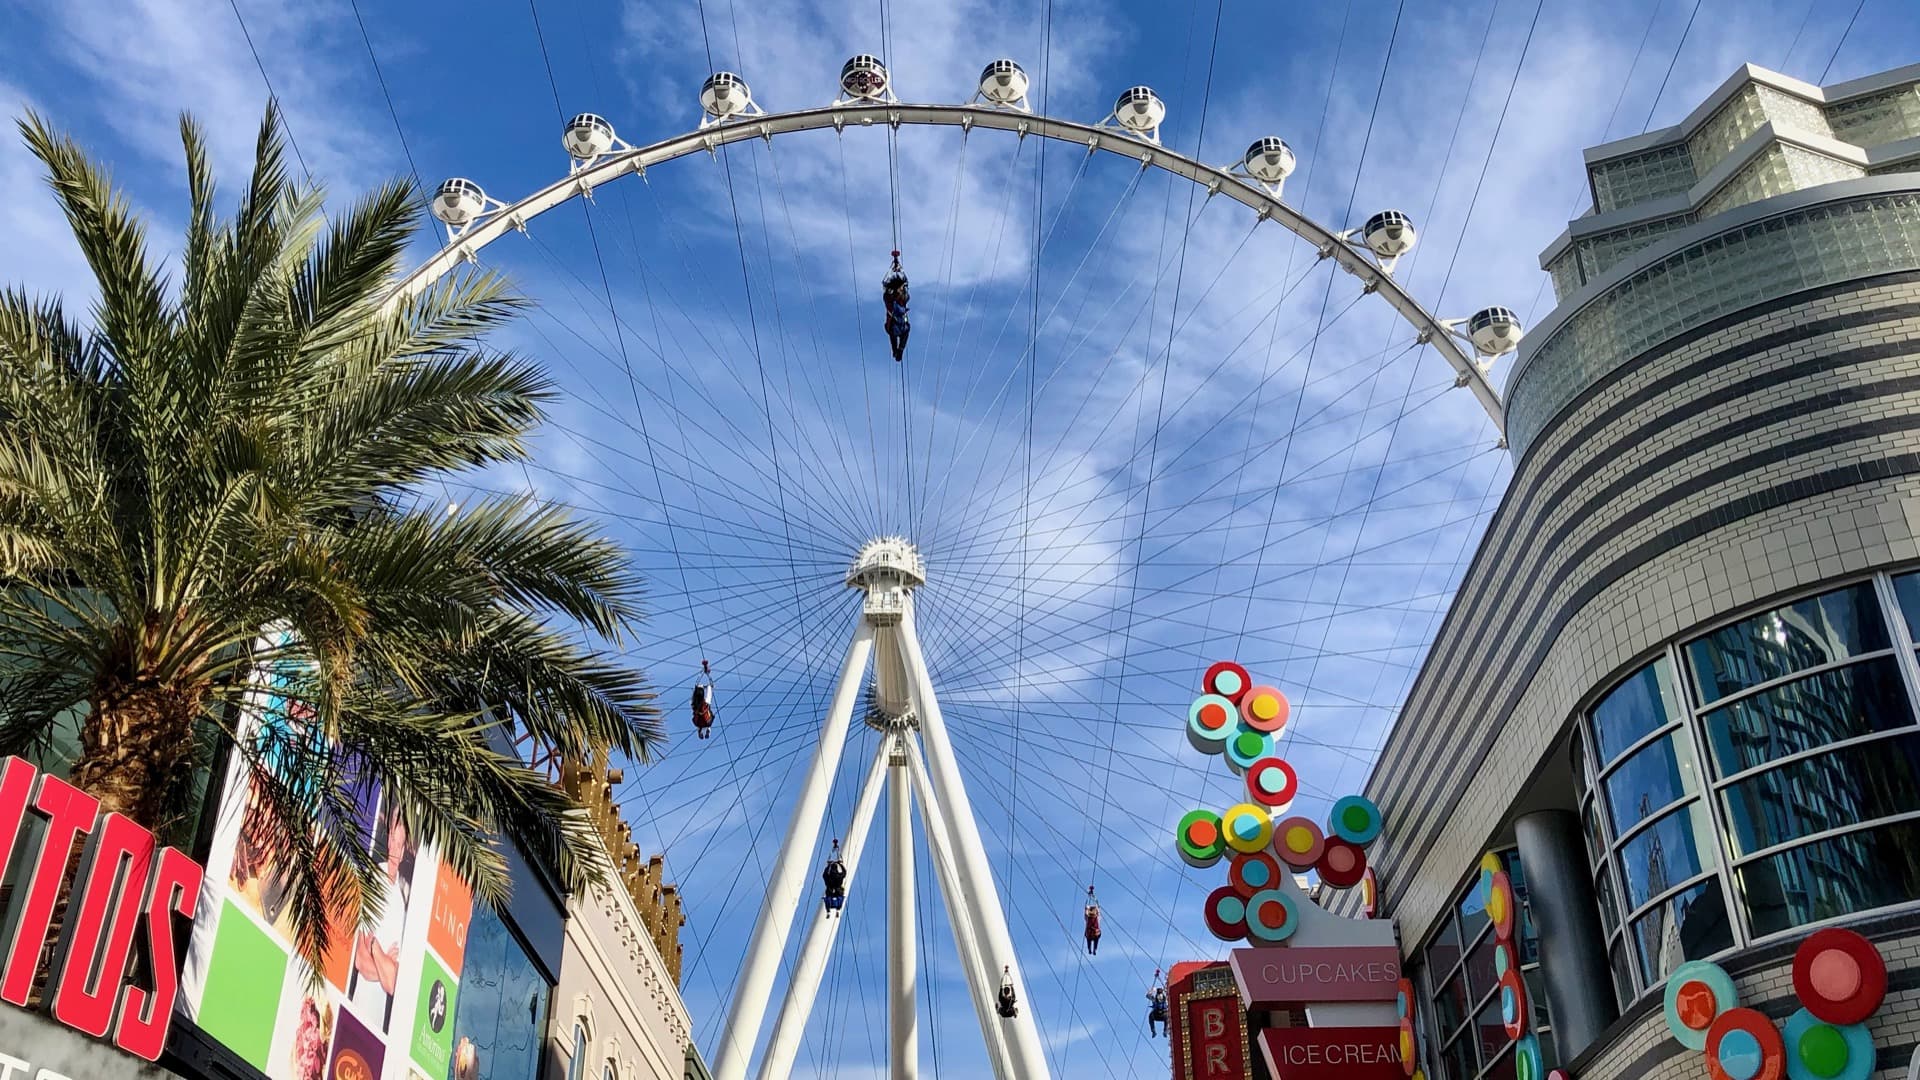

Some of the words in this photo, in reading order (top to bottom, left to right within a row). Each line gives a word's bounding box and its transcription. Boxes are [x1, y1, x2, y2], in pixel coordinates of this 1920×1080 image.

[435, 896, 464, 948] LINQ
[1262, 962, 1398, 984] CUPCAKES
[1283, 1044, 1321, 1065] ICE
